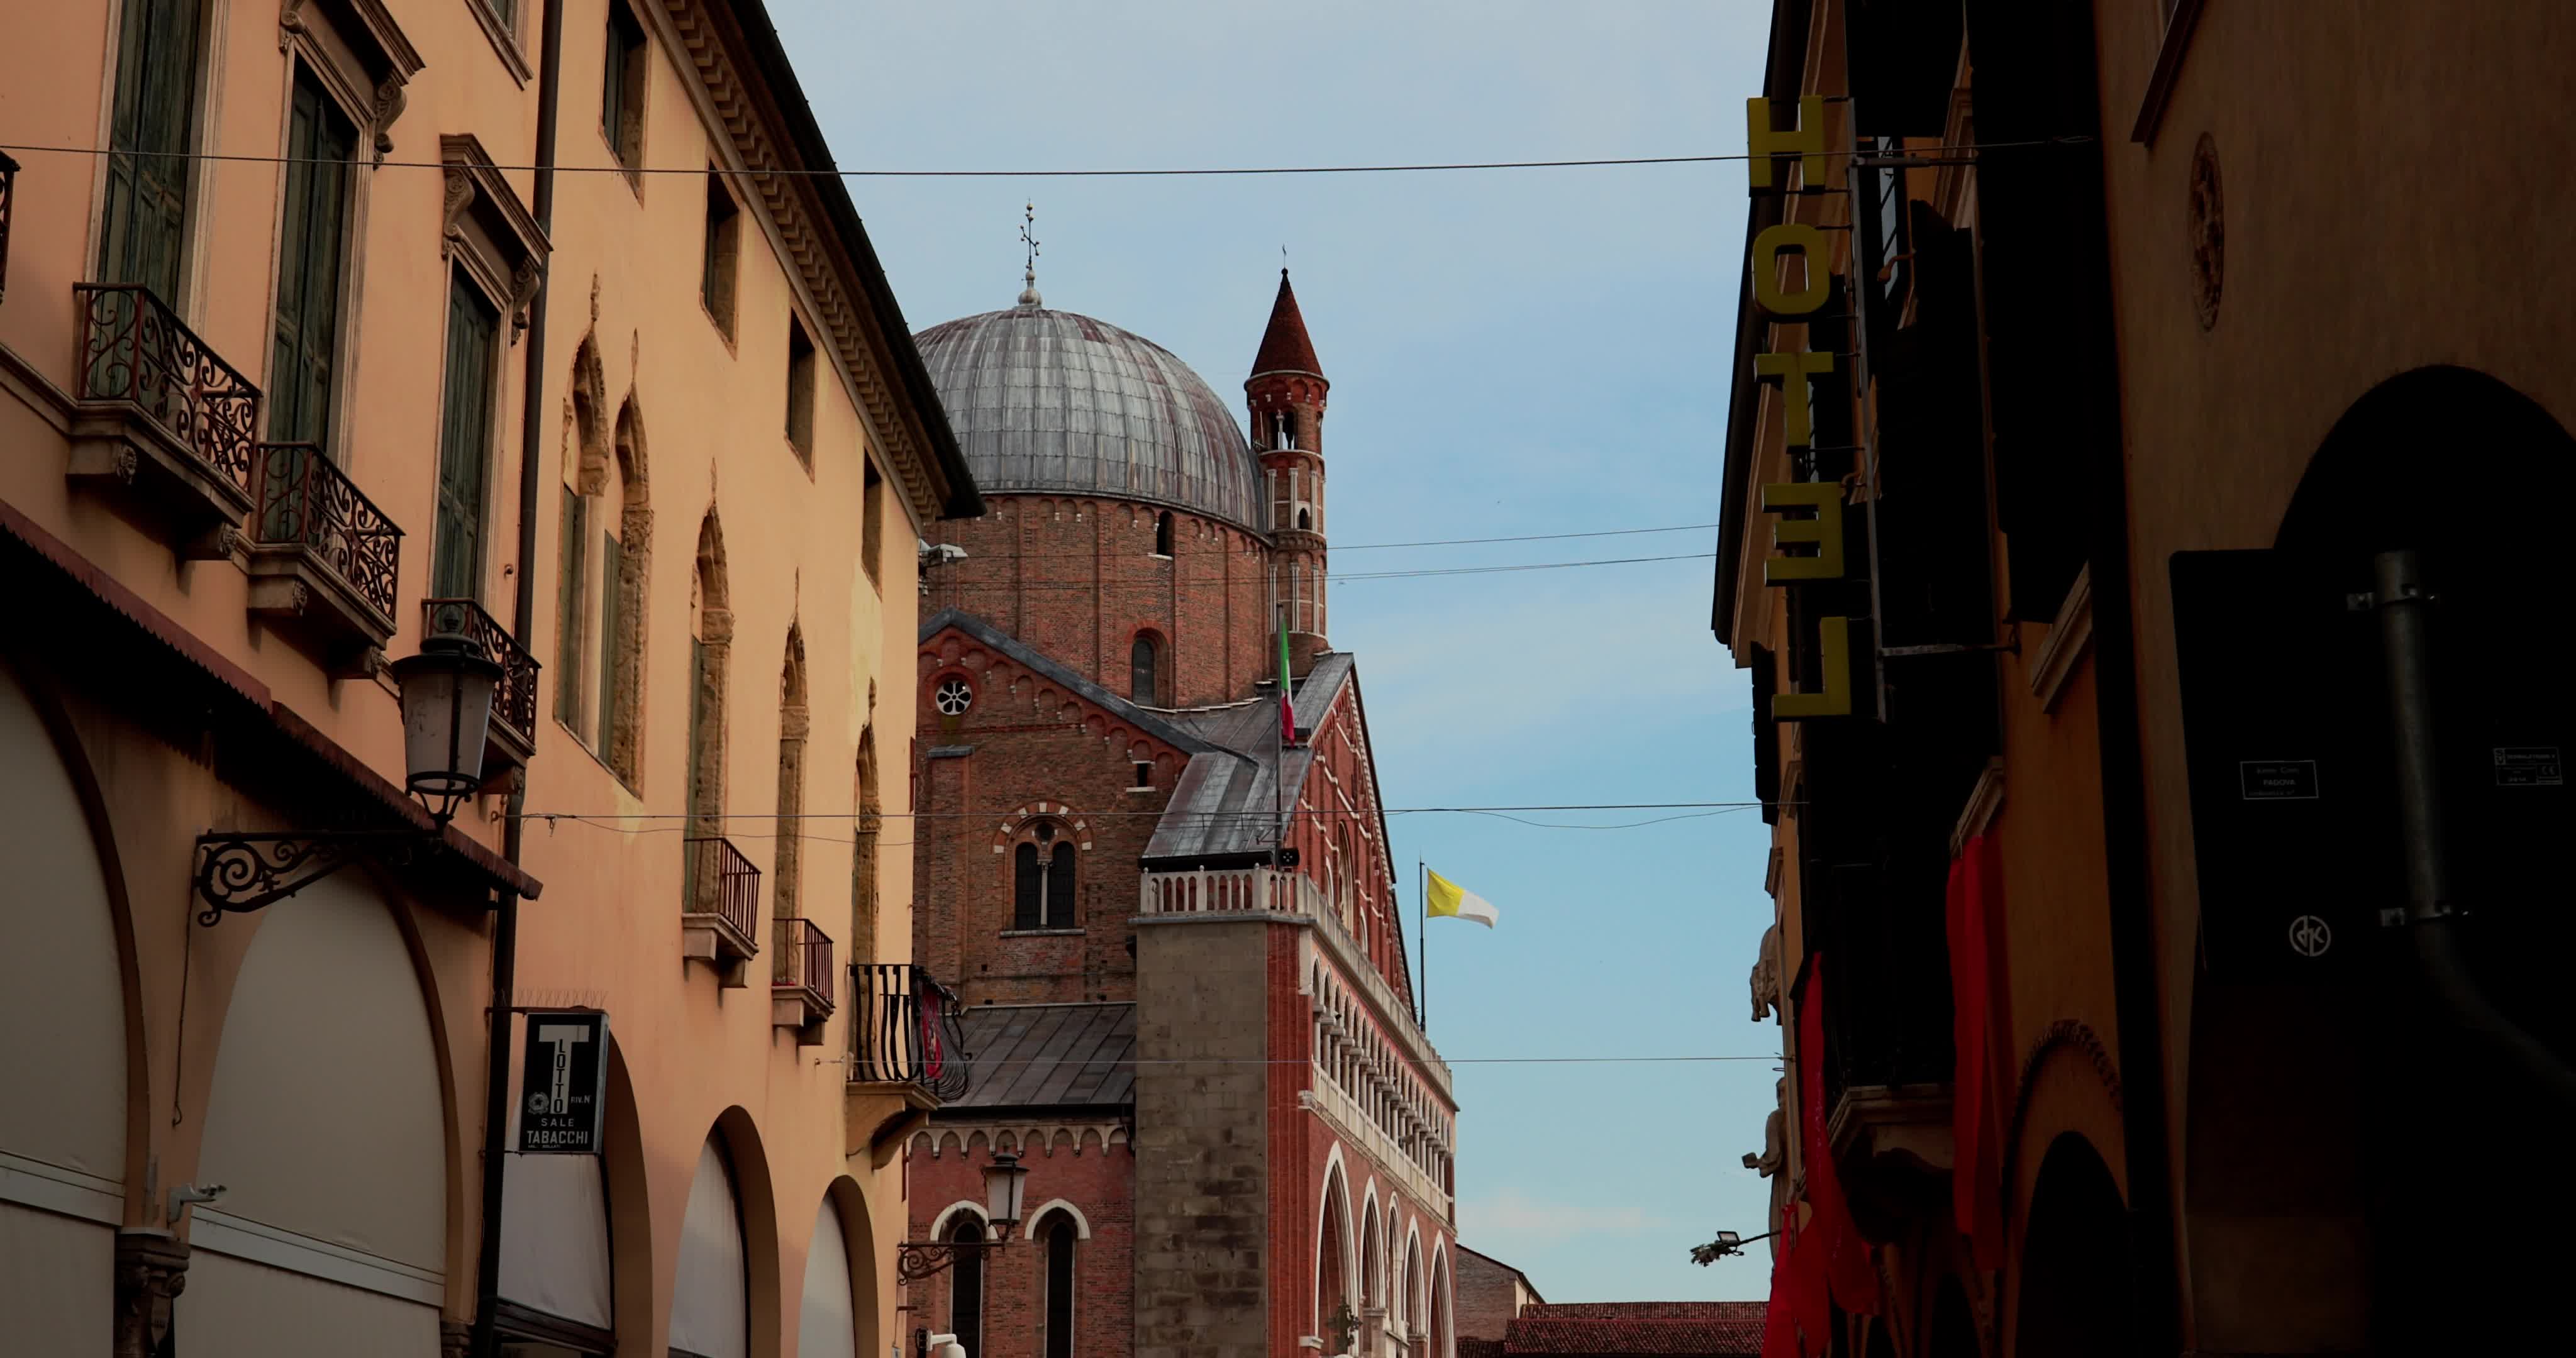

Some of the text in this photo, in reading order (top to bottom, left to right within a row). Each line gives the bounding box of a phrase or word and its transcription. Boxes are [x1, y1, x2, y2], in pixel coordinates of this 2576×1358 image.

[554, 1039, 565, 1113] LOTTO
[541, 1118, 575, 1127] SALE
[527, 1130, 588, 1144] TABACCHI
